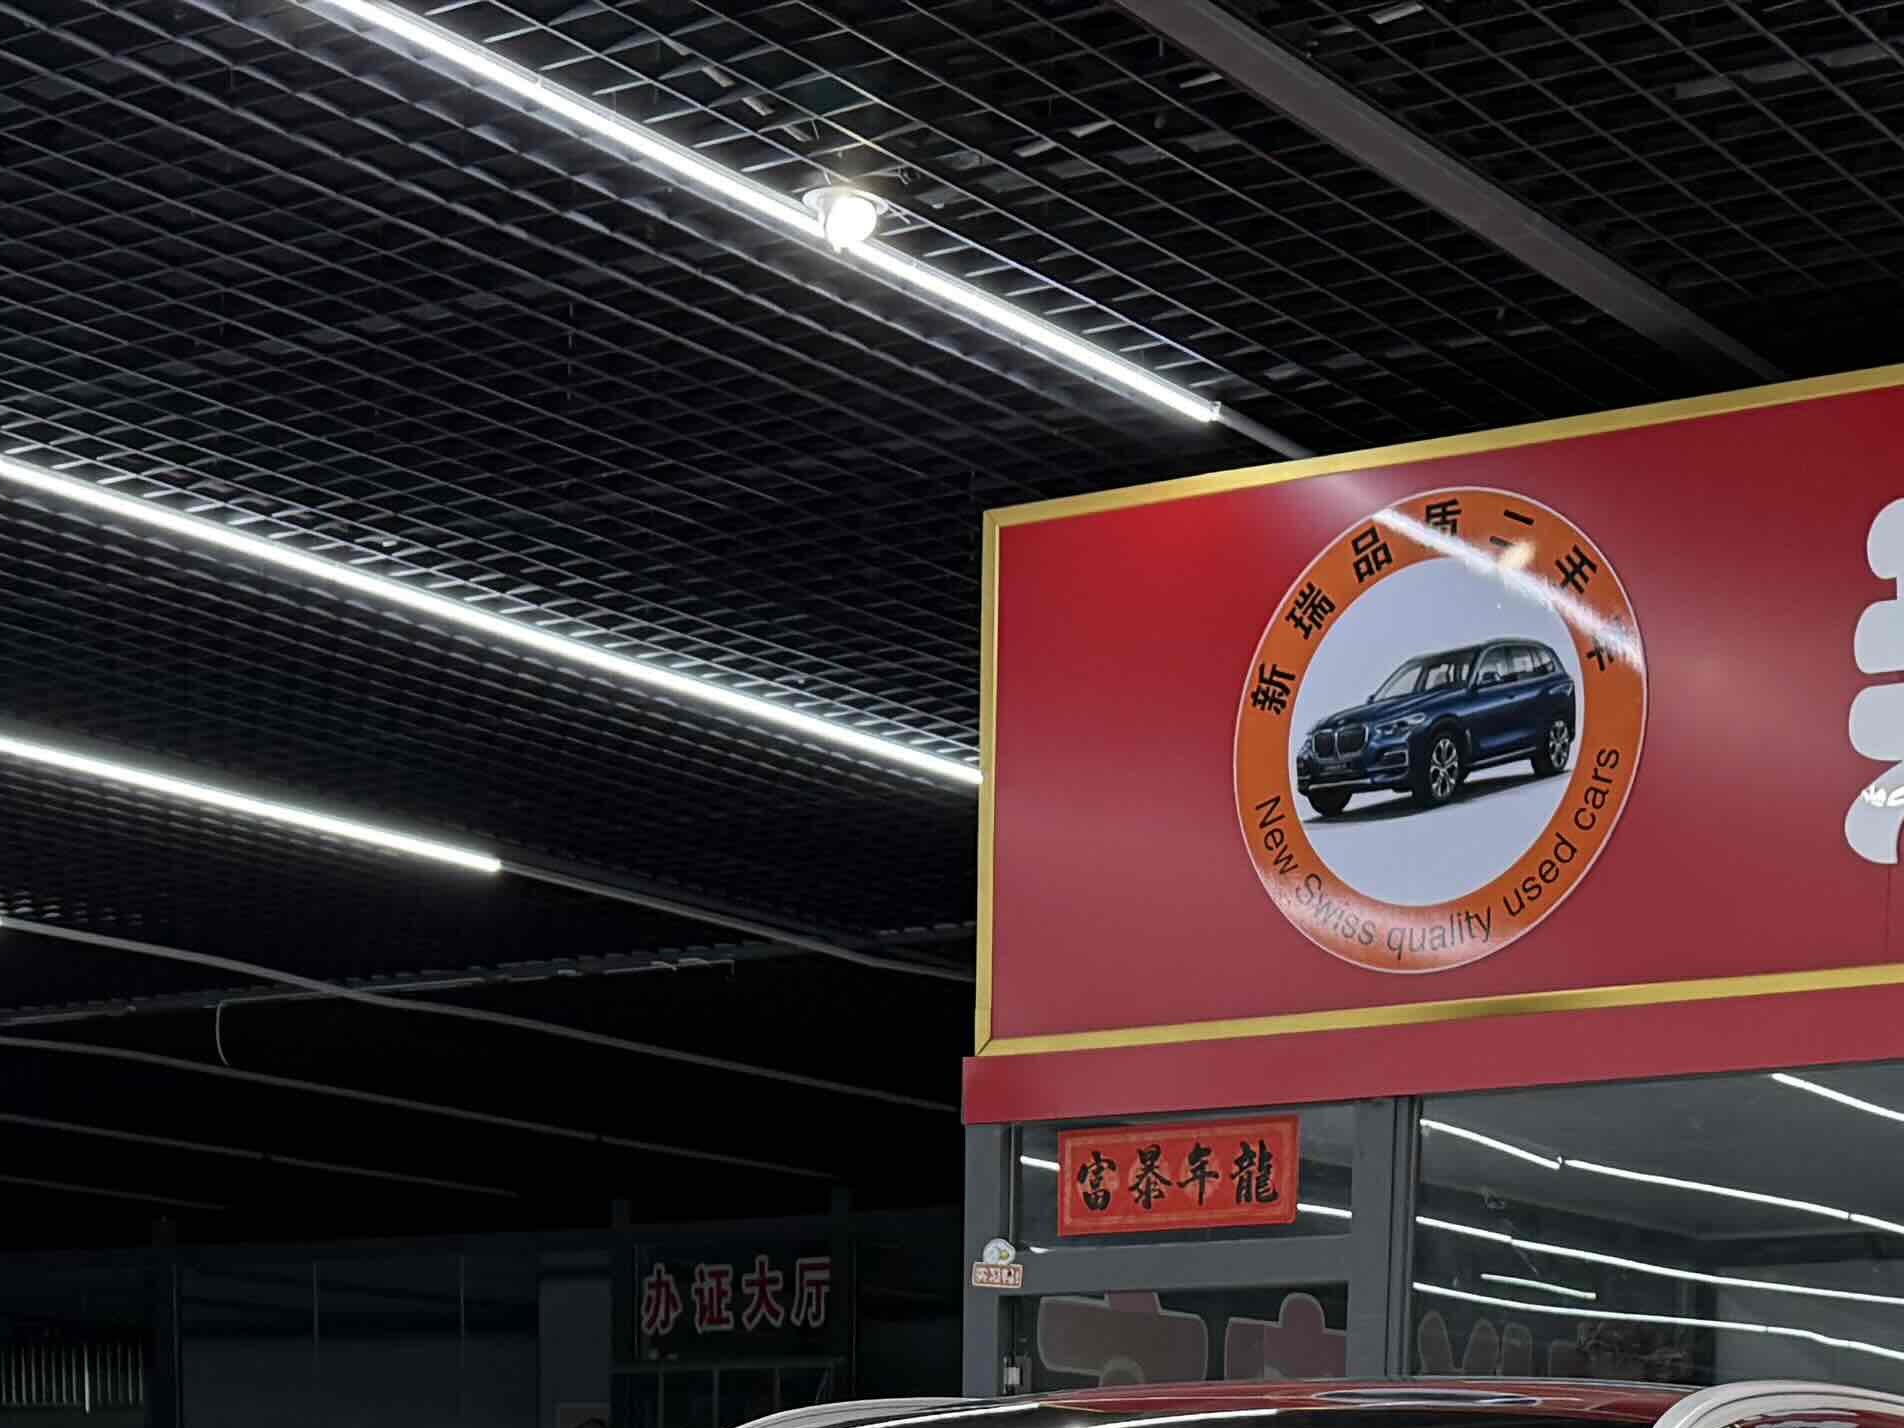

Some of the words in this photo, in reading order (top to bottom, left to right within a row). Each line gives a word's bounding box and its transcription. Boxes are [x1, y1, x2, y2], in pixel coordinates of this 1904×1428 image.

[1255, 795, 1299, 876] New
[1296, 872, 1377, 946] Swiss
[1386, 905, 1494, 960] quality
[1502, 832, 1578, 918] used
[1574, 747, 1621, 832] cars
[641, 1254, 832, 1336] 办证大厅
